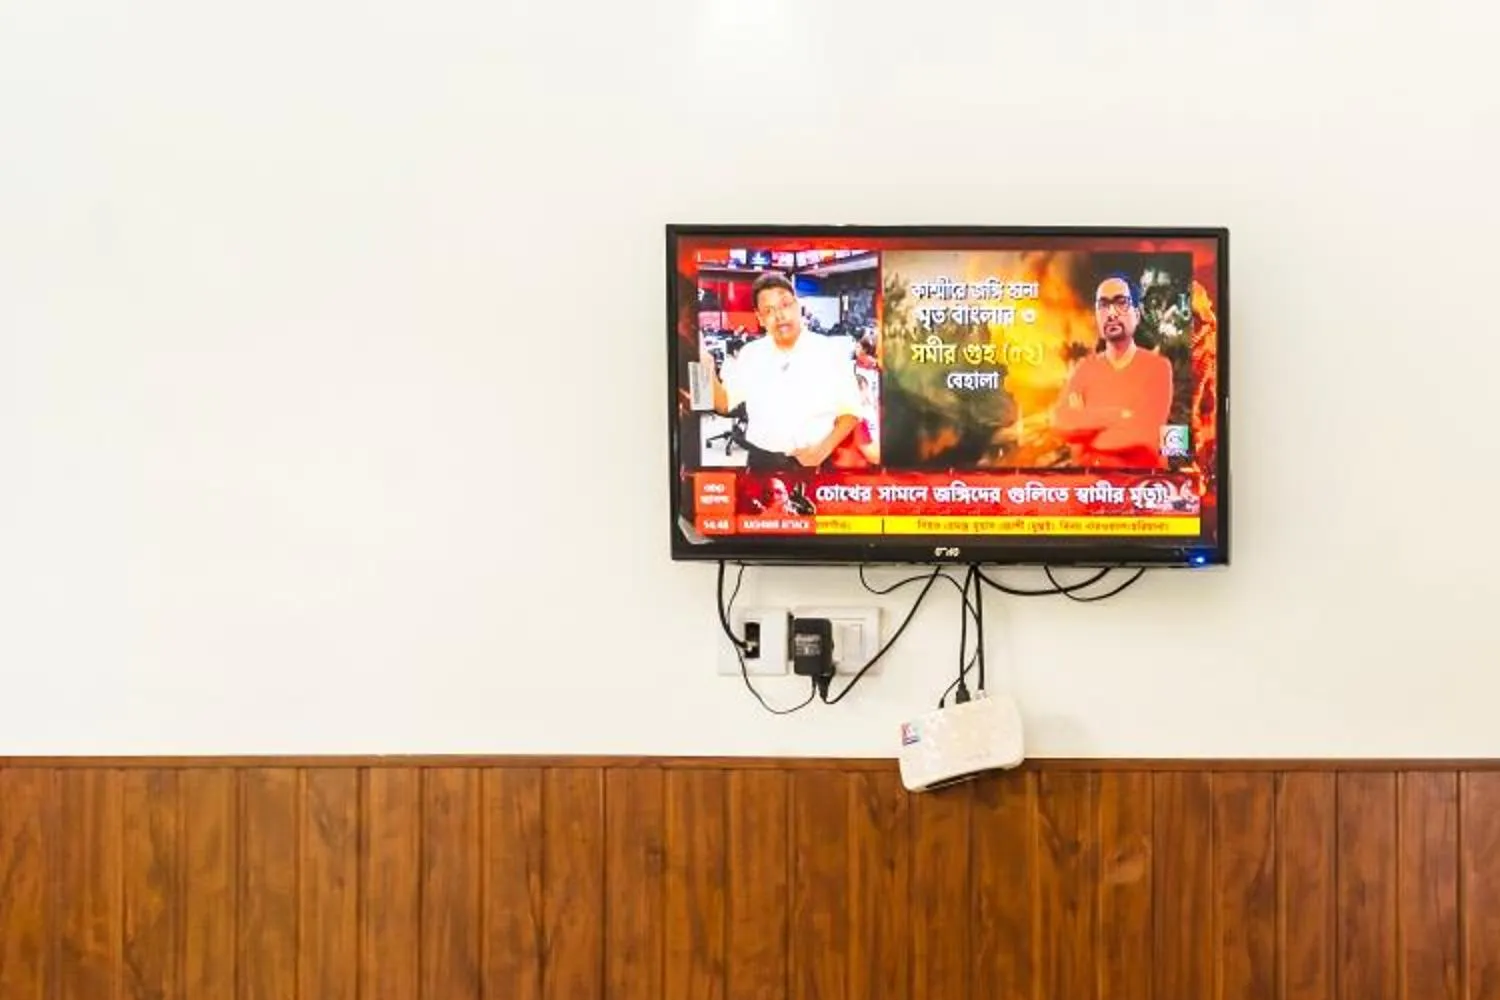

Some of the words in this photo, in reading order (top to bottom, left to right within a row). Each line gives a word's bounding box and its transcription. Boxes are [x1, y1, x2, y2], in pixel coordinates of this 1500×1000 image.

[911, 335, 957, 364] সমীর
[962, 343, 998, 365] গুহ
[946, 370, 1000, 390] বেহালা
[815, 484, 872, 502] চোখের
[877, 484, 928, 502] সামনে
[932, 479, 1002, 505] জঙ্গিদের
[1007, 480, 1069, 504] গুলিতে
[1073, 479, 1125, 505] স্বামীর
